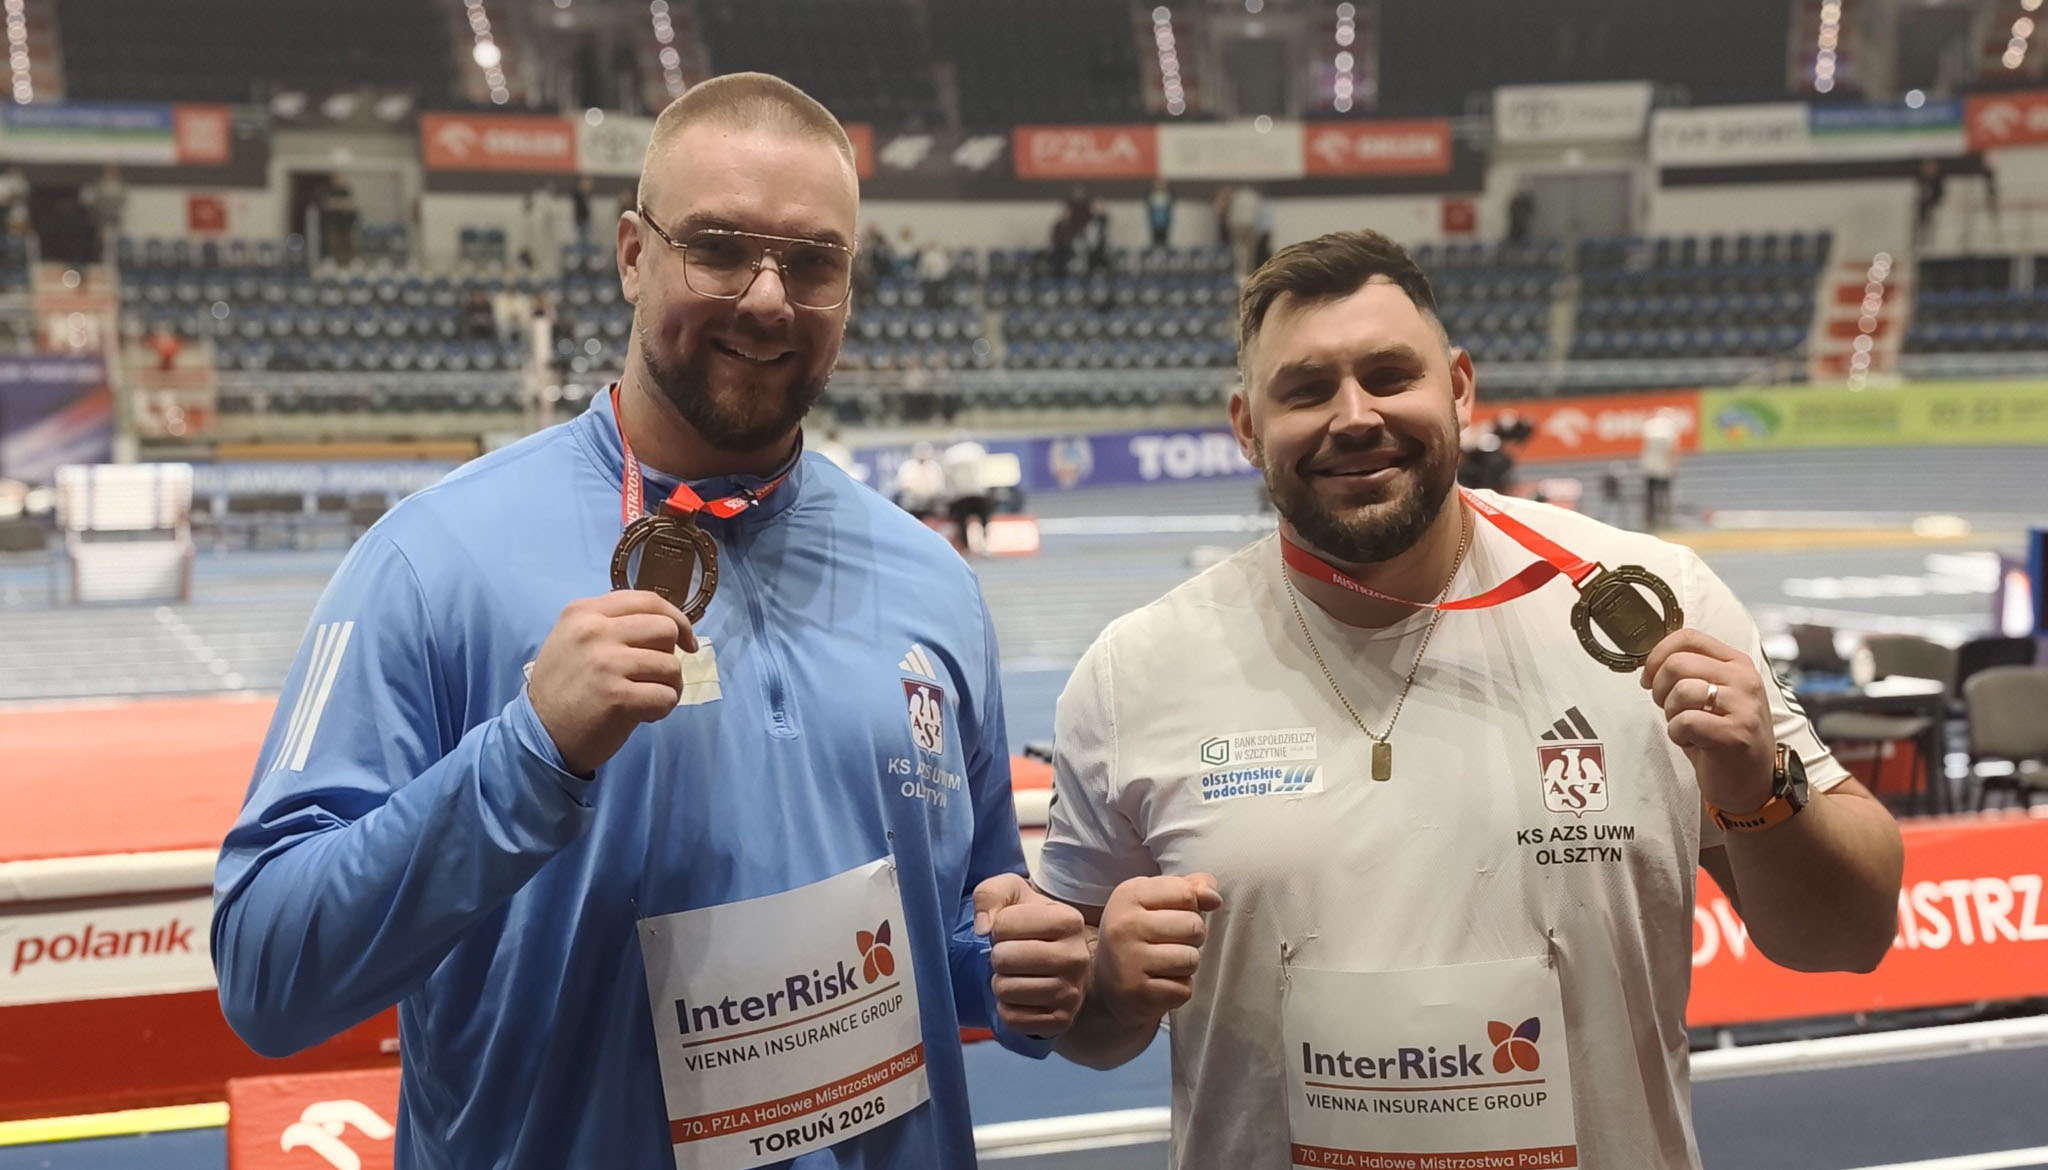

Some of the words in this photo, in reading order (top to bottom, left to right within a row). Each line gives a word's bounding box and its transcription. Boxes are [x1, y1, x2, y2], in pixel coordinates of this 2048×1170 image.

[1234, 736, 1257, 748] BANK
[1258, 732, 1316, 746] SPÓŁDZIELCZY
[1234, 751, 1243, 761] W
[1244, 746, 1288, 760] SZCZYTNIE
[888, 758, 911, 775] KS
[1202, 767, 1282, 788] olsztyńskie
[1203, 780, 1272, 800] wodociągi
[1516, 828, 1544, 846] KS
[1549, 825, 1588, 842] AZS
[1594, 825, 1635, 841] UWM
[1536, 847, 1622, 865] OLSZTYN
[11, 917, 195, 974] polanik
[675, 960, 859, 1035] InterRisk
[685, 1044, 760, 1072] VIENNA
[765, 1013, 859, 1056] INSURANCE
[861, 994, 903, 1025] GROUP
[1302, 1041, 1484, 1080] InterRisk
[682, 1121, 708, 1137] 70.
[712, 1114, 751, 1131] PZLA
[754, 1097, 812, 1122] Halowe
[816, 1069, 889, 1106] Mistrzostwa
[891, 1050, 919, 1076] Polski
[1306, 1092, 1369, 1113] VIENNA
[1374, 1096, 1479, 1114] INSURANCE
[1485, 1091, 1547, 1110] GROUP
[750, 1112, 835, 1157] TORUŃ
[839, 1096, 886, 1131] 2026
[1301, 1148, 1320, 1163] 70.
[1323, 1151, 1355, 1167] PZLA
[1359, 1155, 1416, 1170] Halowe
[1420, 1155, 1514, 1170] Mistrzostwa
[1519, 1149, 1564, 1165] Polski
